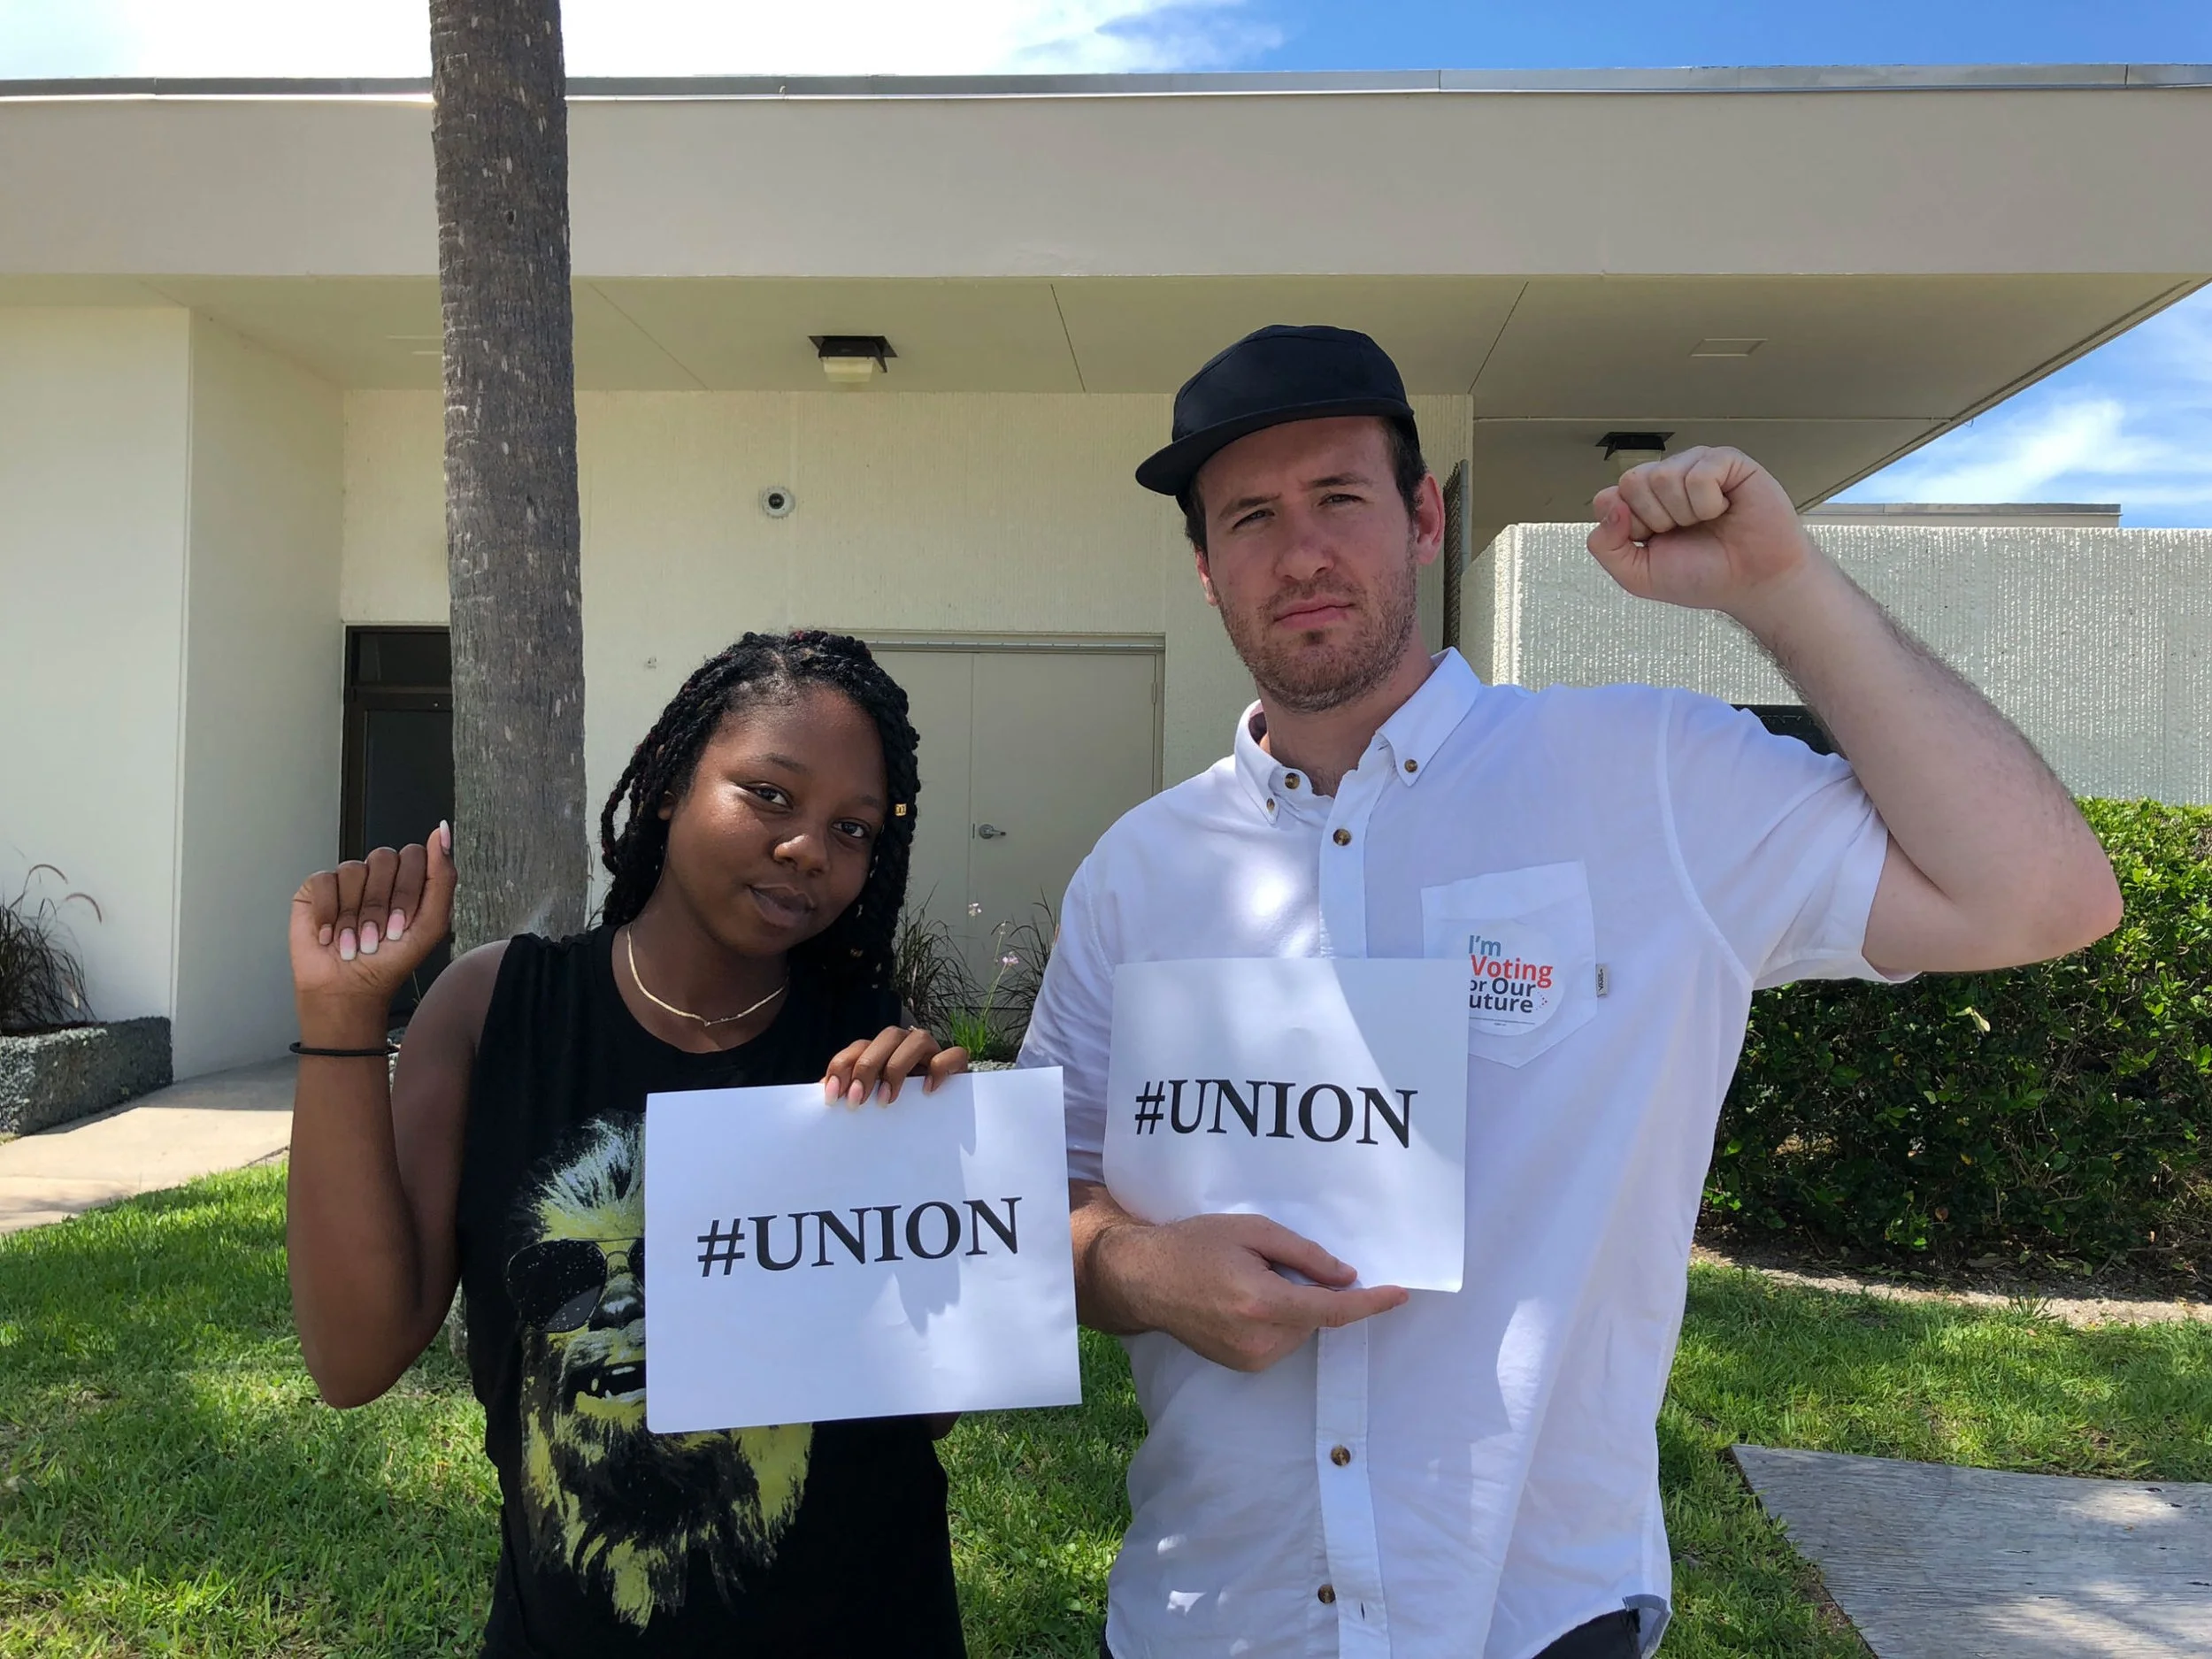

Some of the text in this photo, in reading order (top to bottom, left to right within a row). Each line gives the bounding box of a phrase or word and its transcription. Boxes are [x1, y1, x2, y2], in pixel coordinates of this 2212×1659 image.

[1469, 934, 1502, 956] I'm
[1471, 955, 1554, 989] Voting
[1469, 977, 1536, 997] or Our
[1469, 993, 1533, 1013] uture
[1134, 1079, 1418, 1148] #UNION
[697, 1196, 1023, 1278] #UNION
